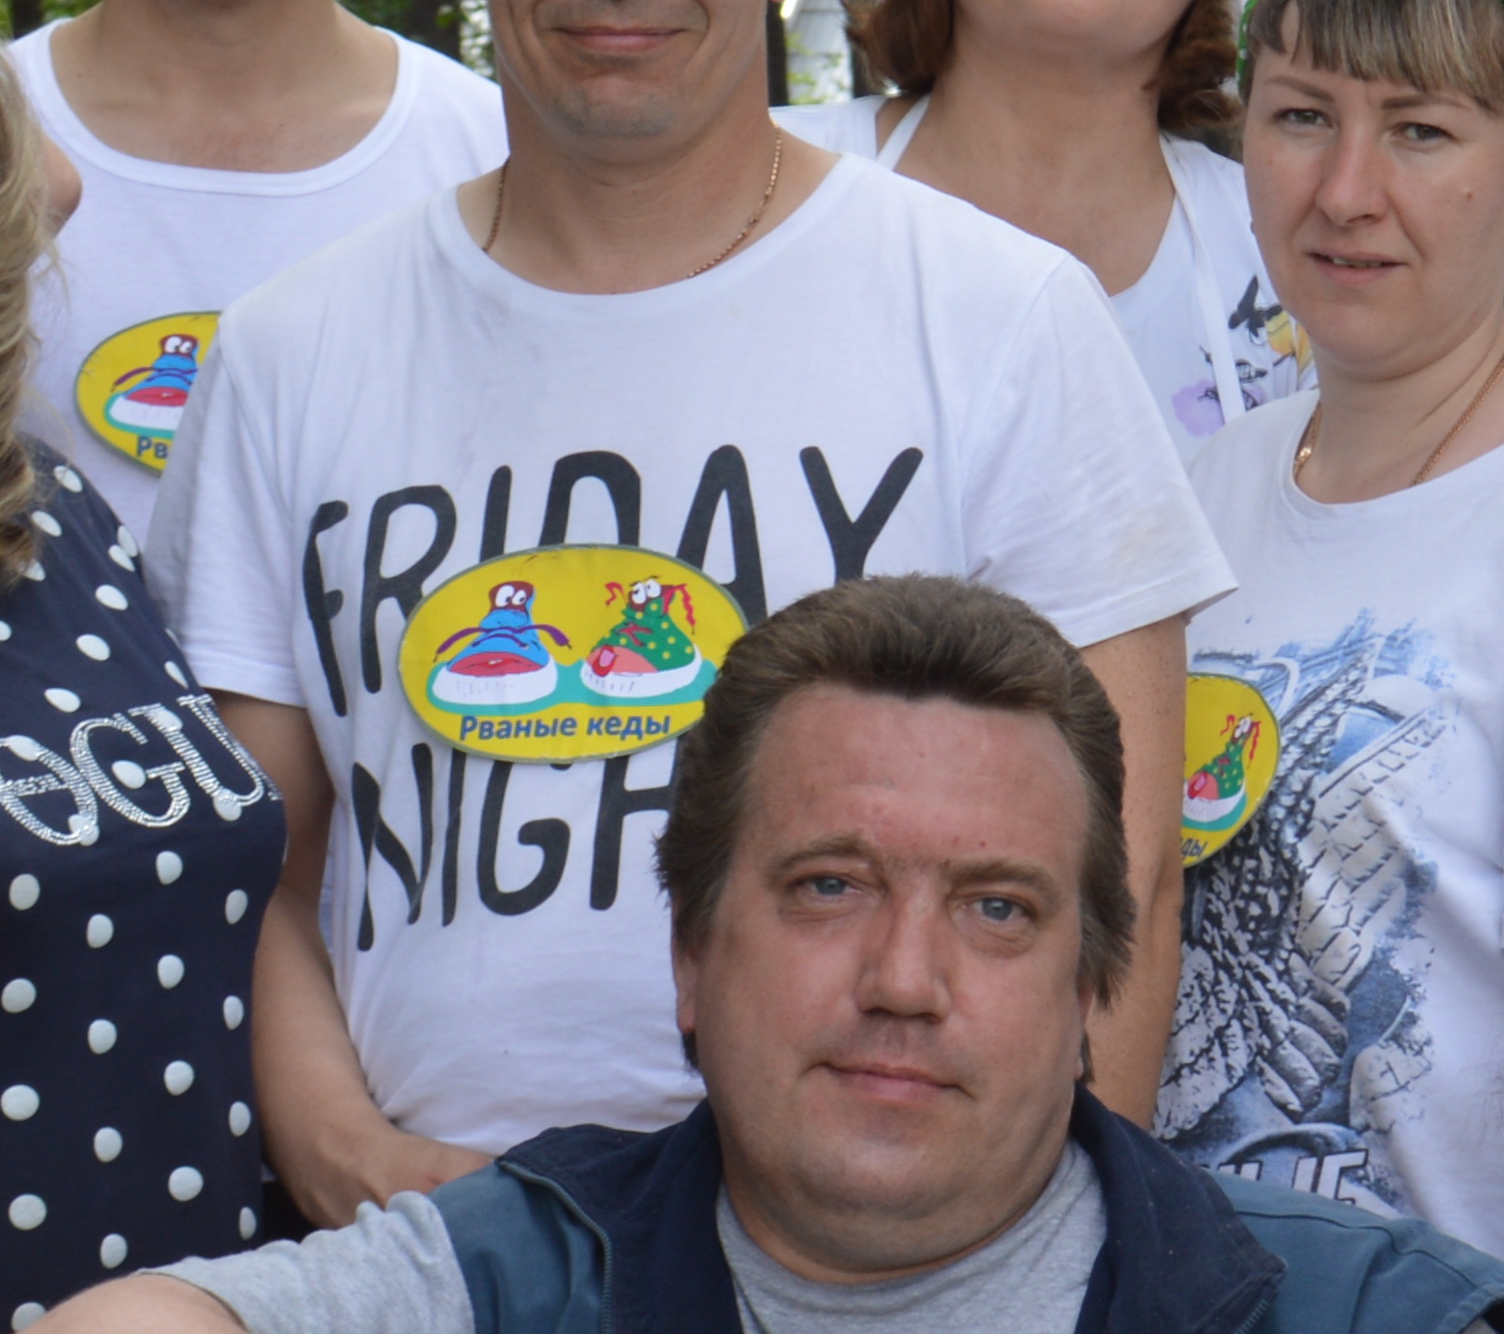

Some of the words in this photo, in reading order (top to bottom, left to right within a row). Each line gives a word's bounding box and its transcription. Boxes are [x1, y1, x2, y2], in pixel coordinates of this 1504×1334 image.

[459, 715, 577, 741] Рваные
[587, 715, 670, 741] кеды
[353, 739, 680, 951] NIGH
